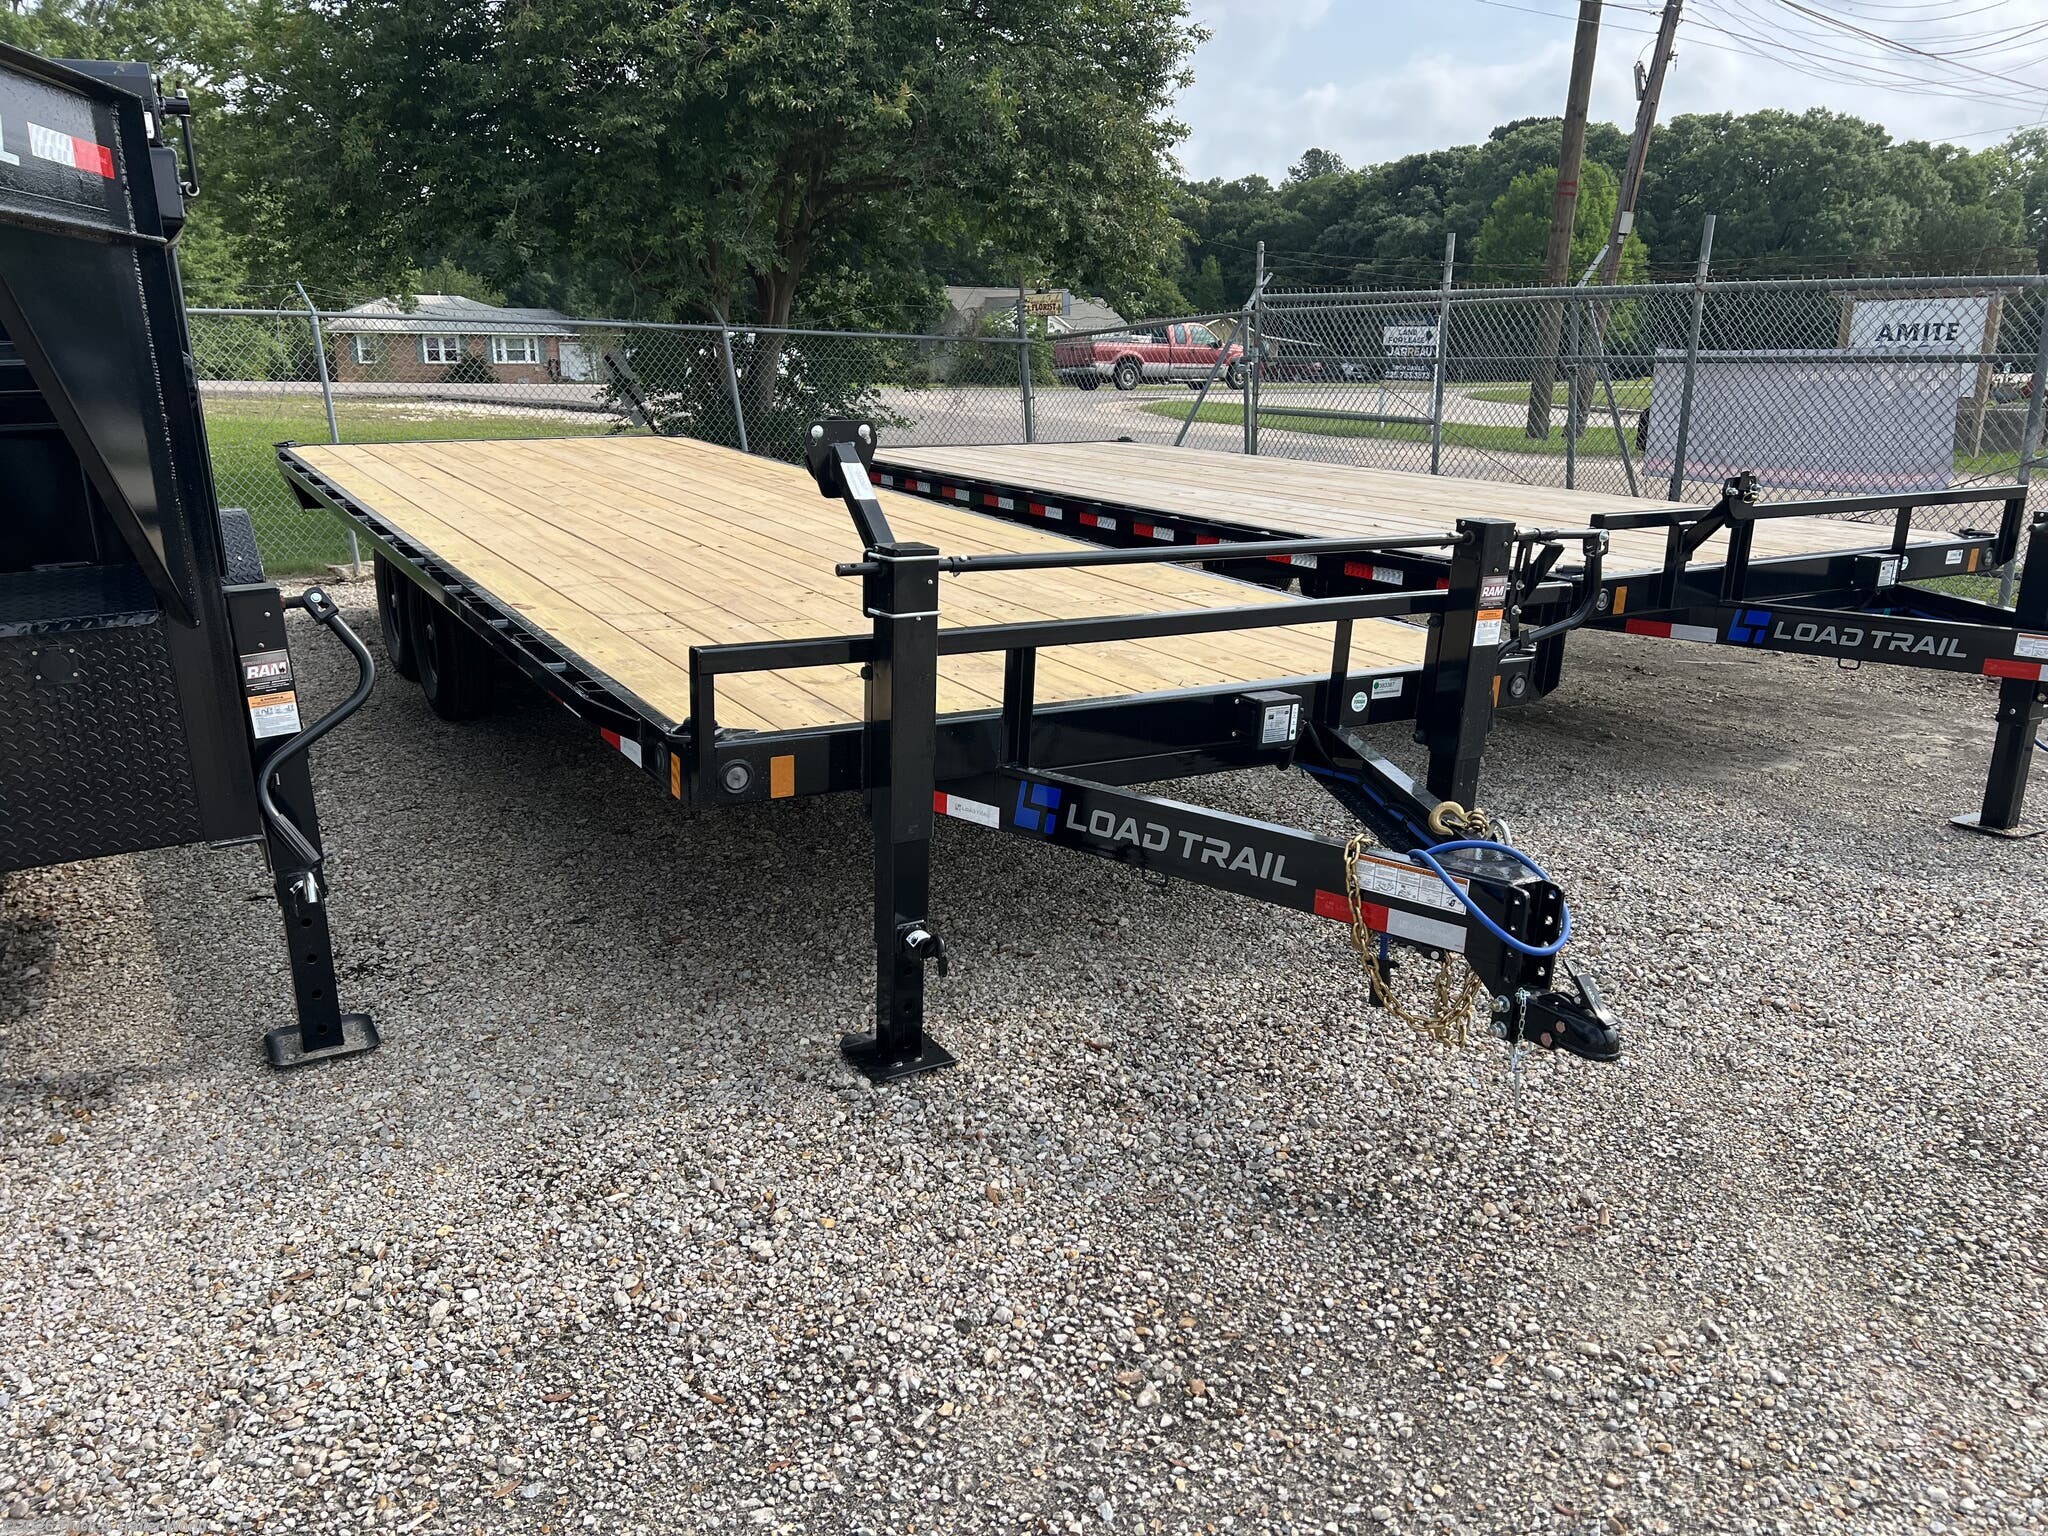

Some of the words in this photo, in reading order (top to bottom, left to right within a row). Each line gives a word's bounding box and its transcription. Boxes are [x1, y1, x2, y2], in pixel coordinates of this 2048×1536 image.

[1031, 303, 1056, 311] FLORIST
[1875, 322, 1961, 341] AMITE
[1387, 347, 1432, 356] JARREAU
[1481, 585, 1505, 597] RAM
[1773, 621, 1863, 647] LOAD
[1870, 630, 1967, 658] TRAIL
[247, 661, 287, 680] RAM
[1066, 804, 1170, 851] LOAD
[1178, 830, 1298, 887] TRAIL
